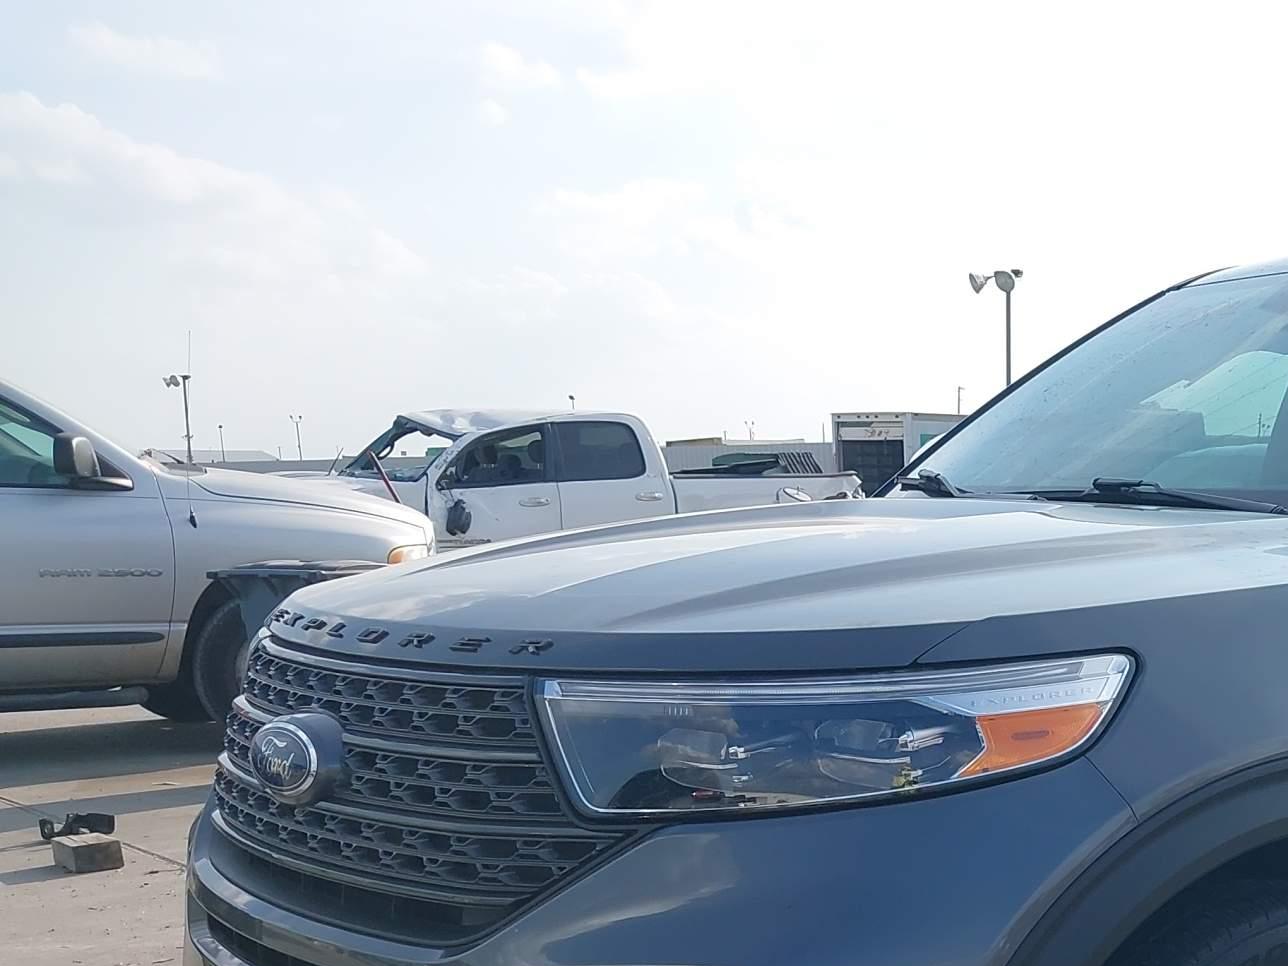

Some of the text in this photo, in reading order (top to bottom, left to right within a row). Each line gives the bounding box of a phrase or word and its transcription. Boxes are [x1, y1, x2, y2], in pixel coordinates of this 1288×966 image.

[39, 568, 163, 577] RAM 2500
[270, 608, 555, 656] EXPLORER
[258, 735, 295, 781] Ford
